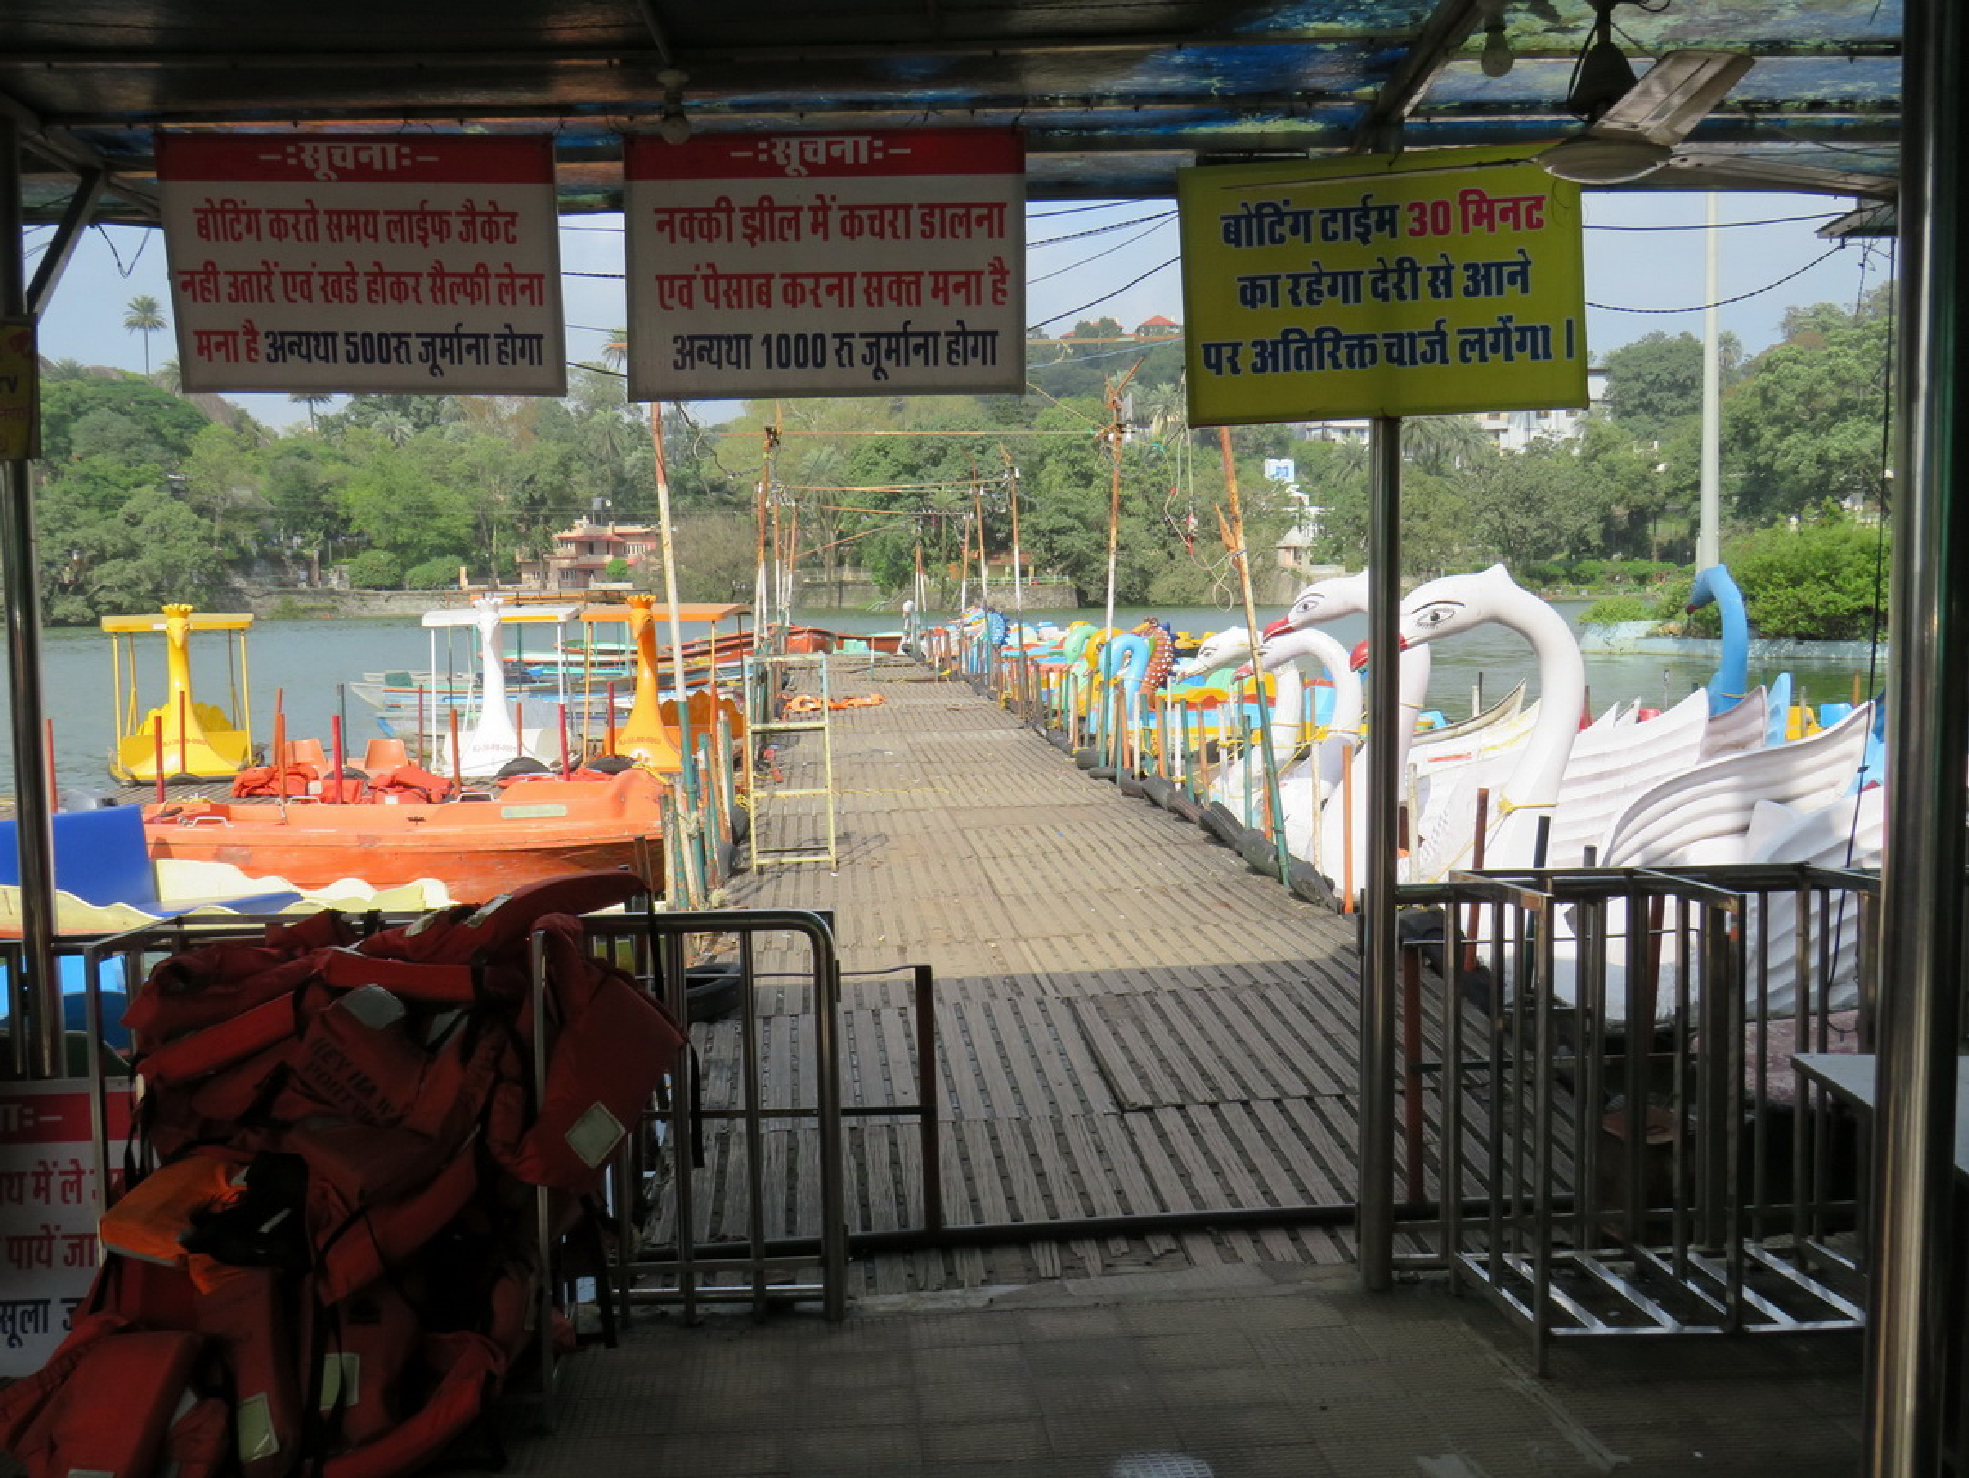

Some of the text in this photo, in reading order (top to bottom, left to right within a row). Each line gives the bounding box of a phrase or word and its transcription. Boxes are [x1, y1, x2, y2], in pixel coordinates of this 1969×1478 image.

[193, 198, 519, 248] बोटिंग करते समय लाईफ जैकेट
[655, 194, 1007, 248] नक्की झील में कचरा डालना
[1220, 188, 1546, 247] बोटिंग टाईम 30 मिनट
[177, 261, 221, 303] नही
[225, 261, 279, 303] उतारें
[282, 262, 317, 303] एवं
[365, 262, 424, 305] होकर
[426, 260, 491, 305] सैल्फी
[494, 263, 545, 306] लेना
[655, 264, 700, 311] एवं
[701, 263, 775, 308] पेसाब
[780, 272, 856, 307] करना
[928, 271, 984, 306] मना
[988, 256, 1010, 305] है
[1237, 248, 1531, 309] का रहेगा देरी से आने
[193, 329, 238, 362] मना
[242, 320, 259, 362] है
[264, 330, 339, 364] अन्यथा
[416, 323, 491, 376] जूर्माना
[494, 324, 543, 365] होगा
[673, 333, 753, 370] अन्यथा
[760, 333, 826, 369] 1000
[859, 320, 941, 380] जूर्माना
[944, 320, 998, 365] होगा
[1201, 342, 1243, 375] पर
[1251, 325, 1378, 373] अतिरिक्त
[1382, 319, 1449, 366] चार्ज
[31, 1158, 59, 1205] में
[61, 1233, 98, 1268] जा
